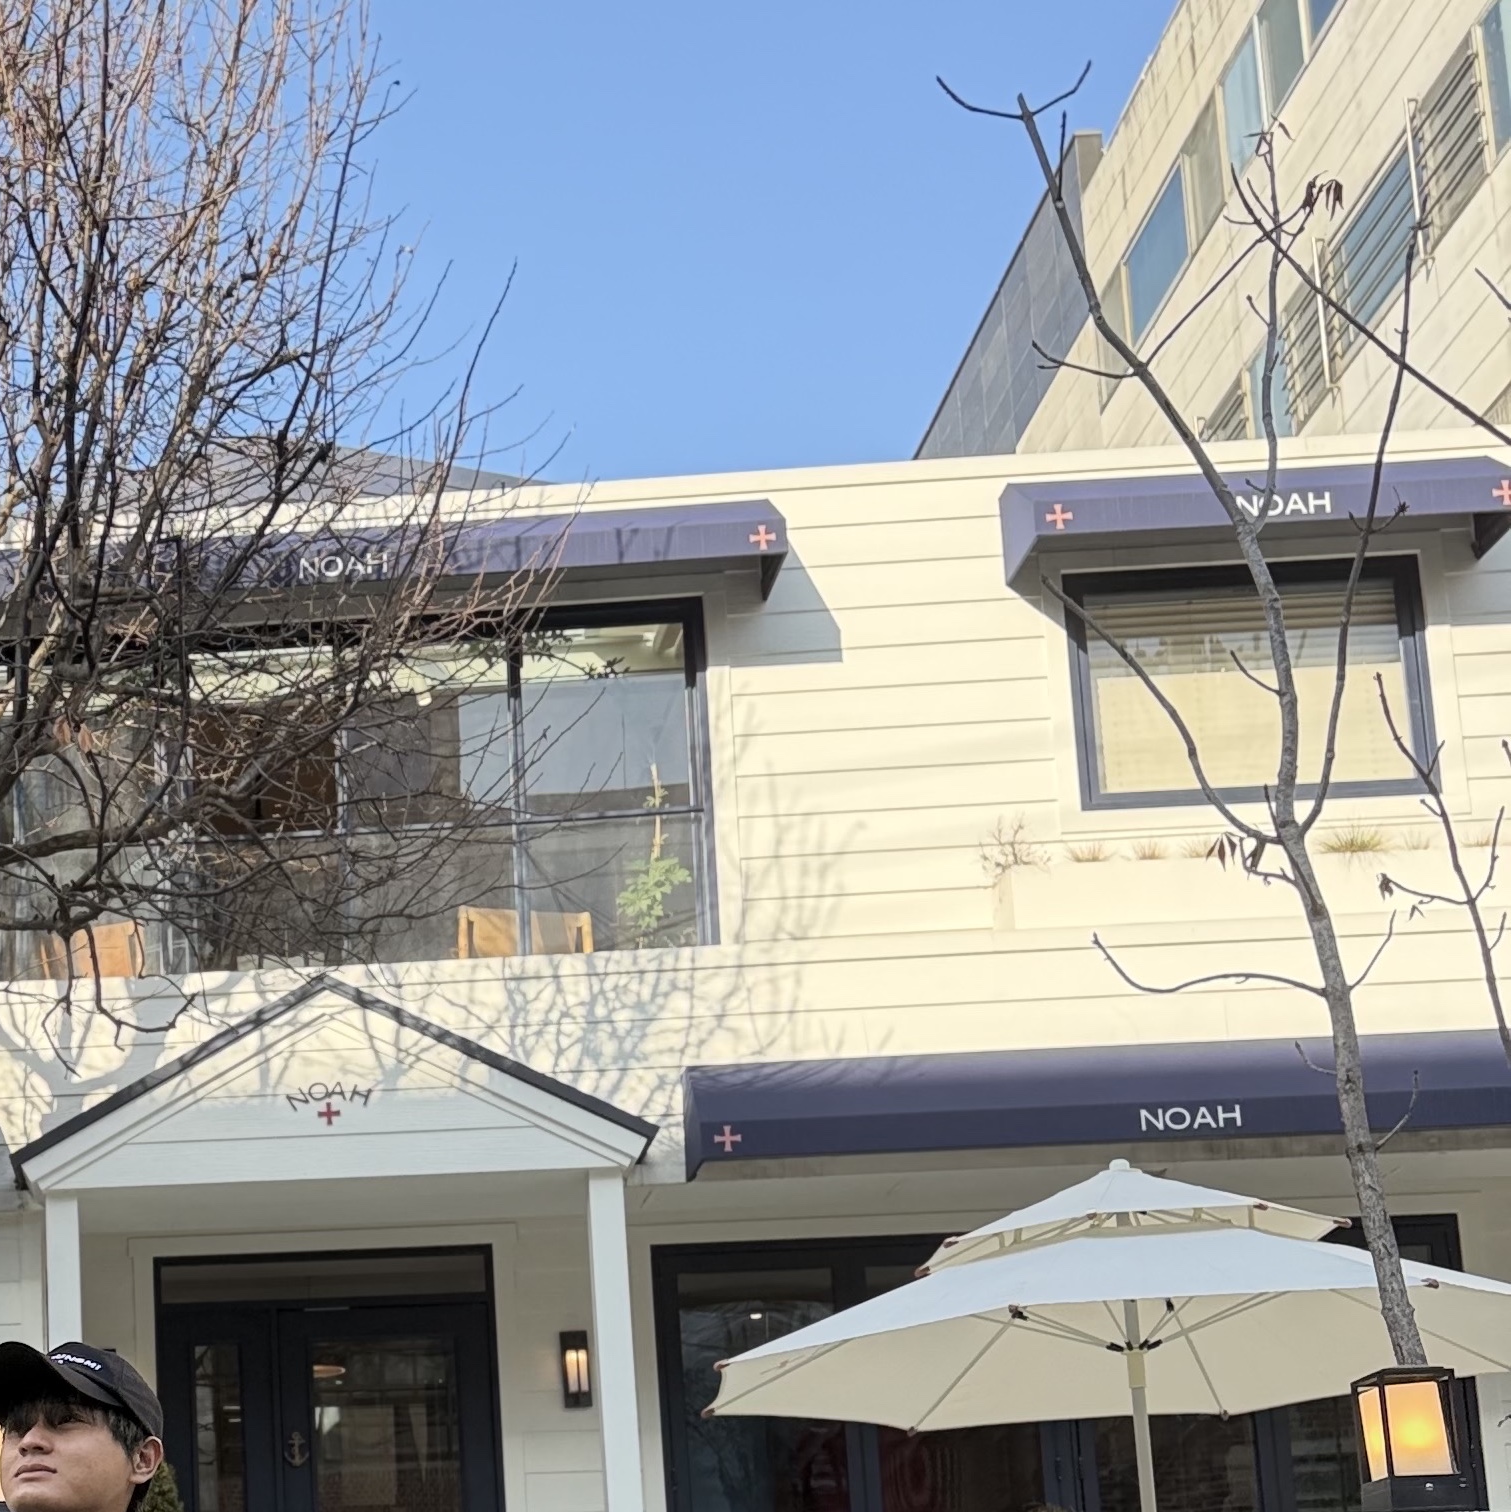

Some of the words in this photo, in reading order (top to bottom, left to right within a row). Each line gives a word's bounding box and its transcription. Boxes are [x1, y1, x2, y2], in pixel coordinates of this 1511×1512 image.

[299, 552, 388, 579] NOAH
[286, 1081, 373, 1112] NOAH
[1139, 1104, 1242, 1132] NOAH
